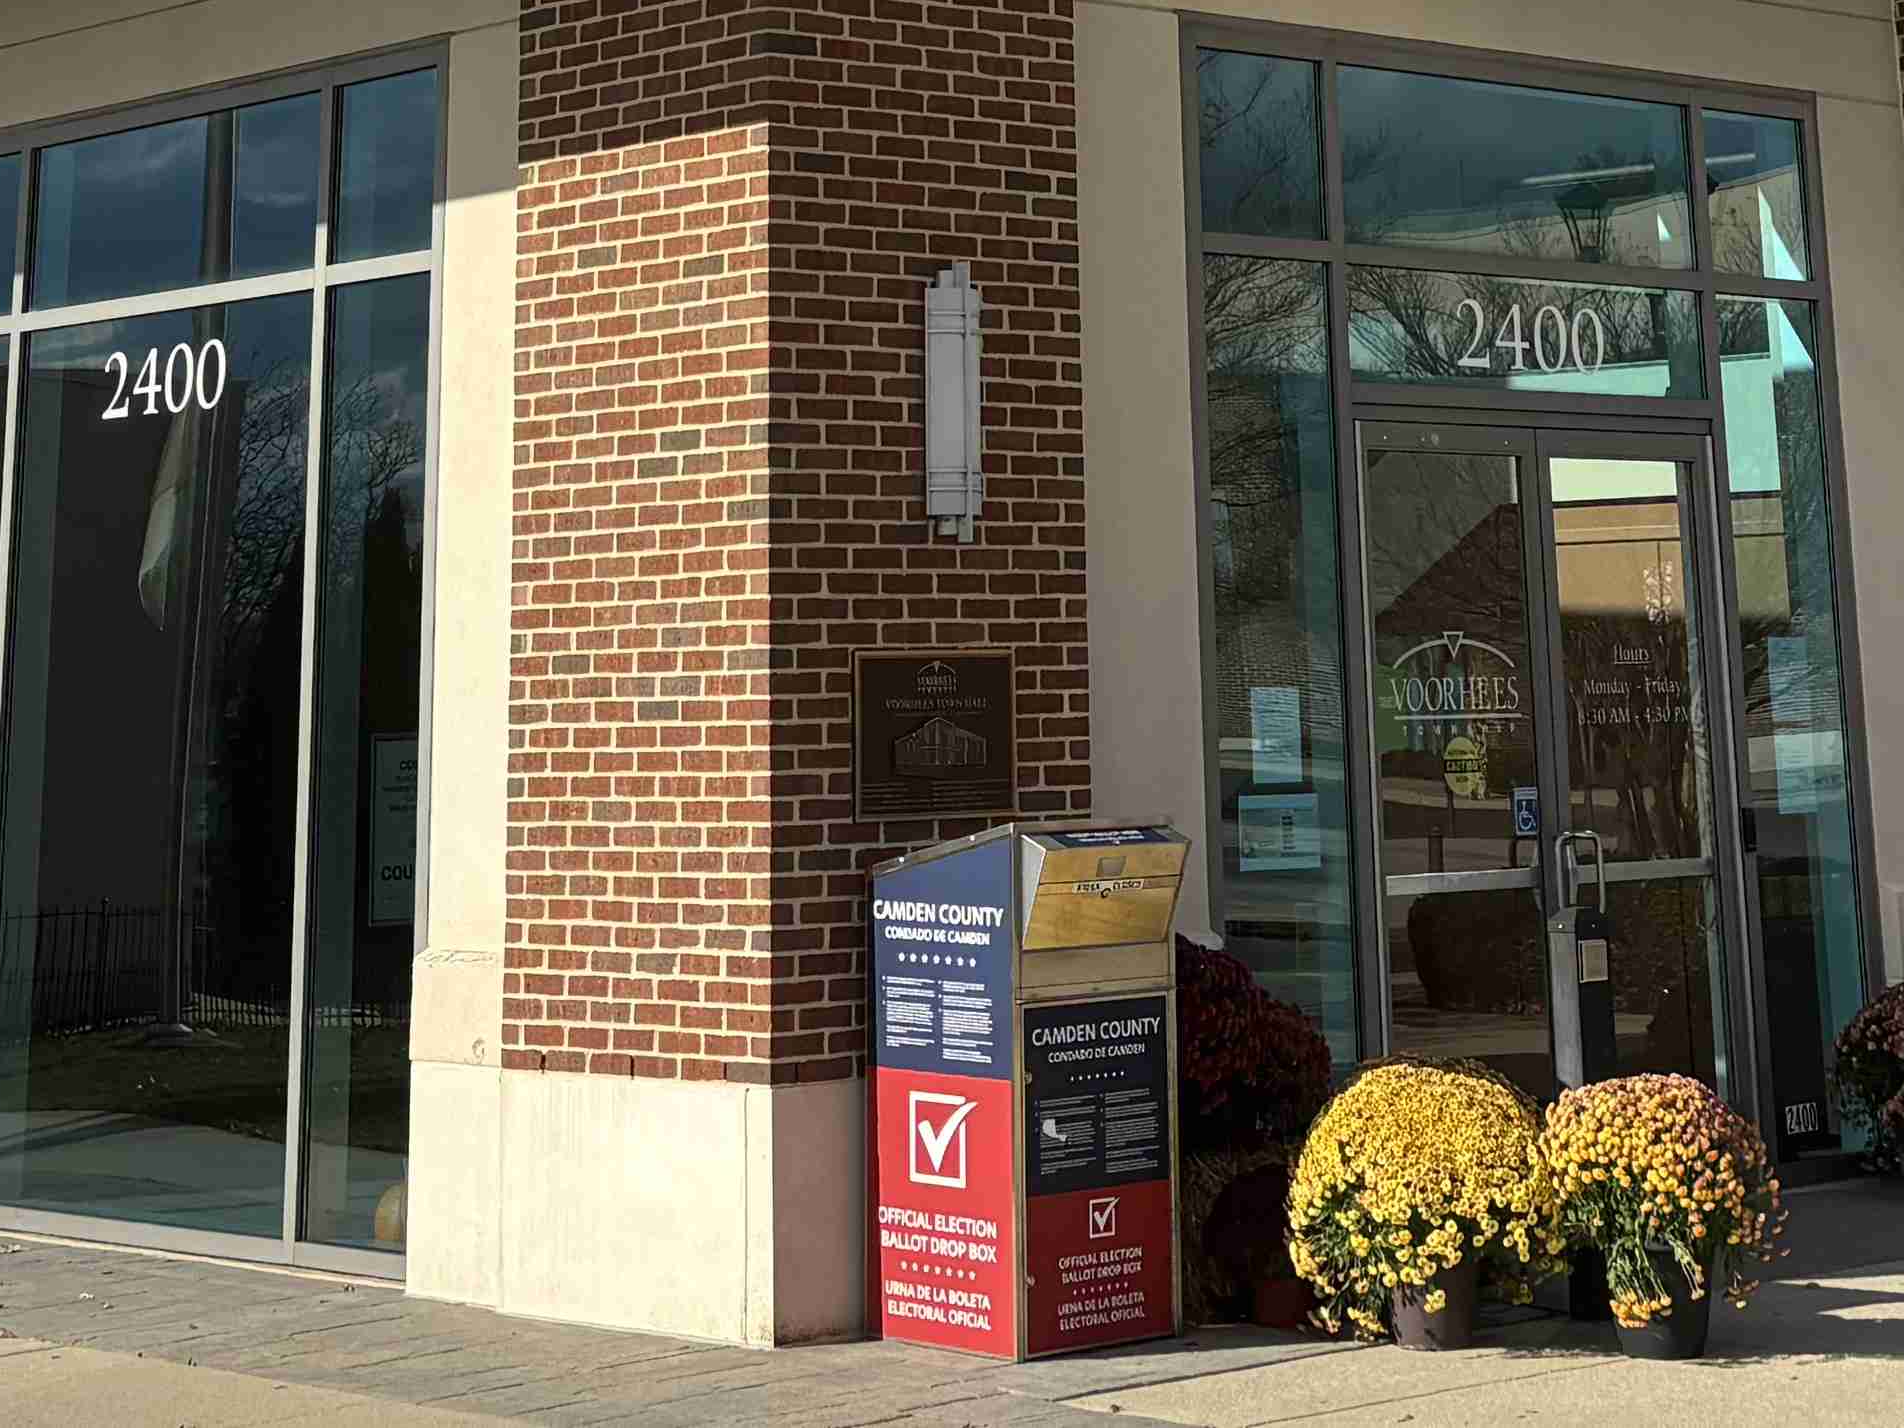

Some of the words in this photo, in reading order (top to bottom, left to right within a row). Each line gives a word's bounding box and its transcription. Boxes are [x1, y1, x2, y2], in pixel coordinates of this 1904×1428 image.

[1456, 298, 1604, 376] 2400
[102, 338, 227, 420] 2400
[1614, 644, 1650, 662] Hours
[1390, 676, 1519, 712] VOORHEES
[1583, 677, 1632, 697] Monday
[1645, 675, 1682, 698] Friday
[1609, 706, 1632, 725] AM
[873, 898, 936, 923] CAMDEN
[938, 904, 1004, 927] COUNTY
[884, 925, 932, 942] CONDADO
[933, 929, 946, 943] DE
[947, 930, 991, 945] CAMDEN
[1032, 1023, 1096, 1047] CAMDEN
[1099, 1017, 1161, 1040] COUNTY
[1047, 1048, 1093, 1063] CONDADO
[1094, 1046, 1107, 1058] DE
[1108, 1043, 1146, 1057] CAMDEN
[878, 1205, 933, 1230] OFFICIAL
[934, 1213, 998, 1240] ELECTION
[880, 1228, 929, 1253] BALLOT
[930, 1236, 967, 1259] DROP
[968, 1242, 998, 1264] BOX
[1058, 1252, 1097, 1270] OFFICIAL
[1099, 1247, 1143, 1264] ELECTION
[1061, 1267, 1096, 1285] BALLOT
[1097, 1263, 1122, 1279] DROP
[1123, 1261, 1142, 1275] BOX
[884, 1279, 916, 1300] URNA
[916, 1284, 932, 1301] DE
[932, 1287, 948, 1305] LA
[948, 1289, 992, 1311] BOLETA
[1057, 1300, 1084, 1316] URNA
[1084, 1298, 1096, 1312] DE
[1097, 1296, 1110, 1310] LA
[1111, 1291, 1145, 1307] BOLETA
[887, 1299, 948, 1323] ELECTORAL
[948, 1308, 992, 1331] OFICIAL
[1059, 1311, 1110, 1331] ELECTORAL
[1110, 1305, 1146, 1322] OFICIAL
